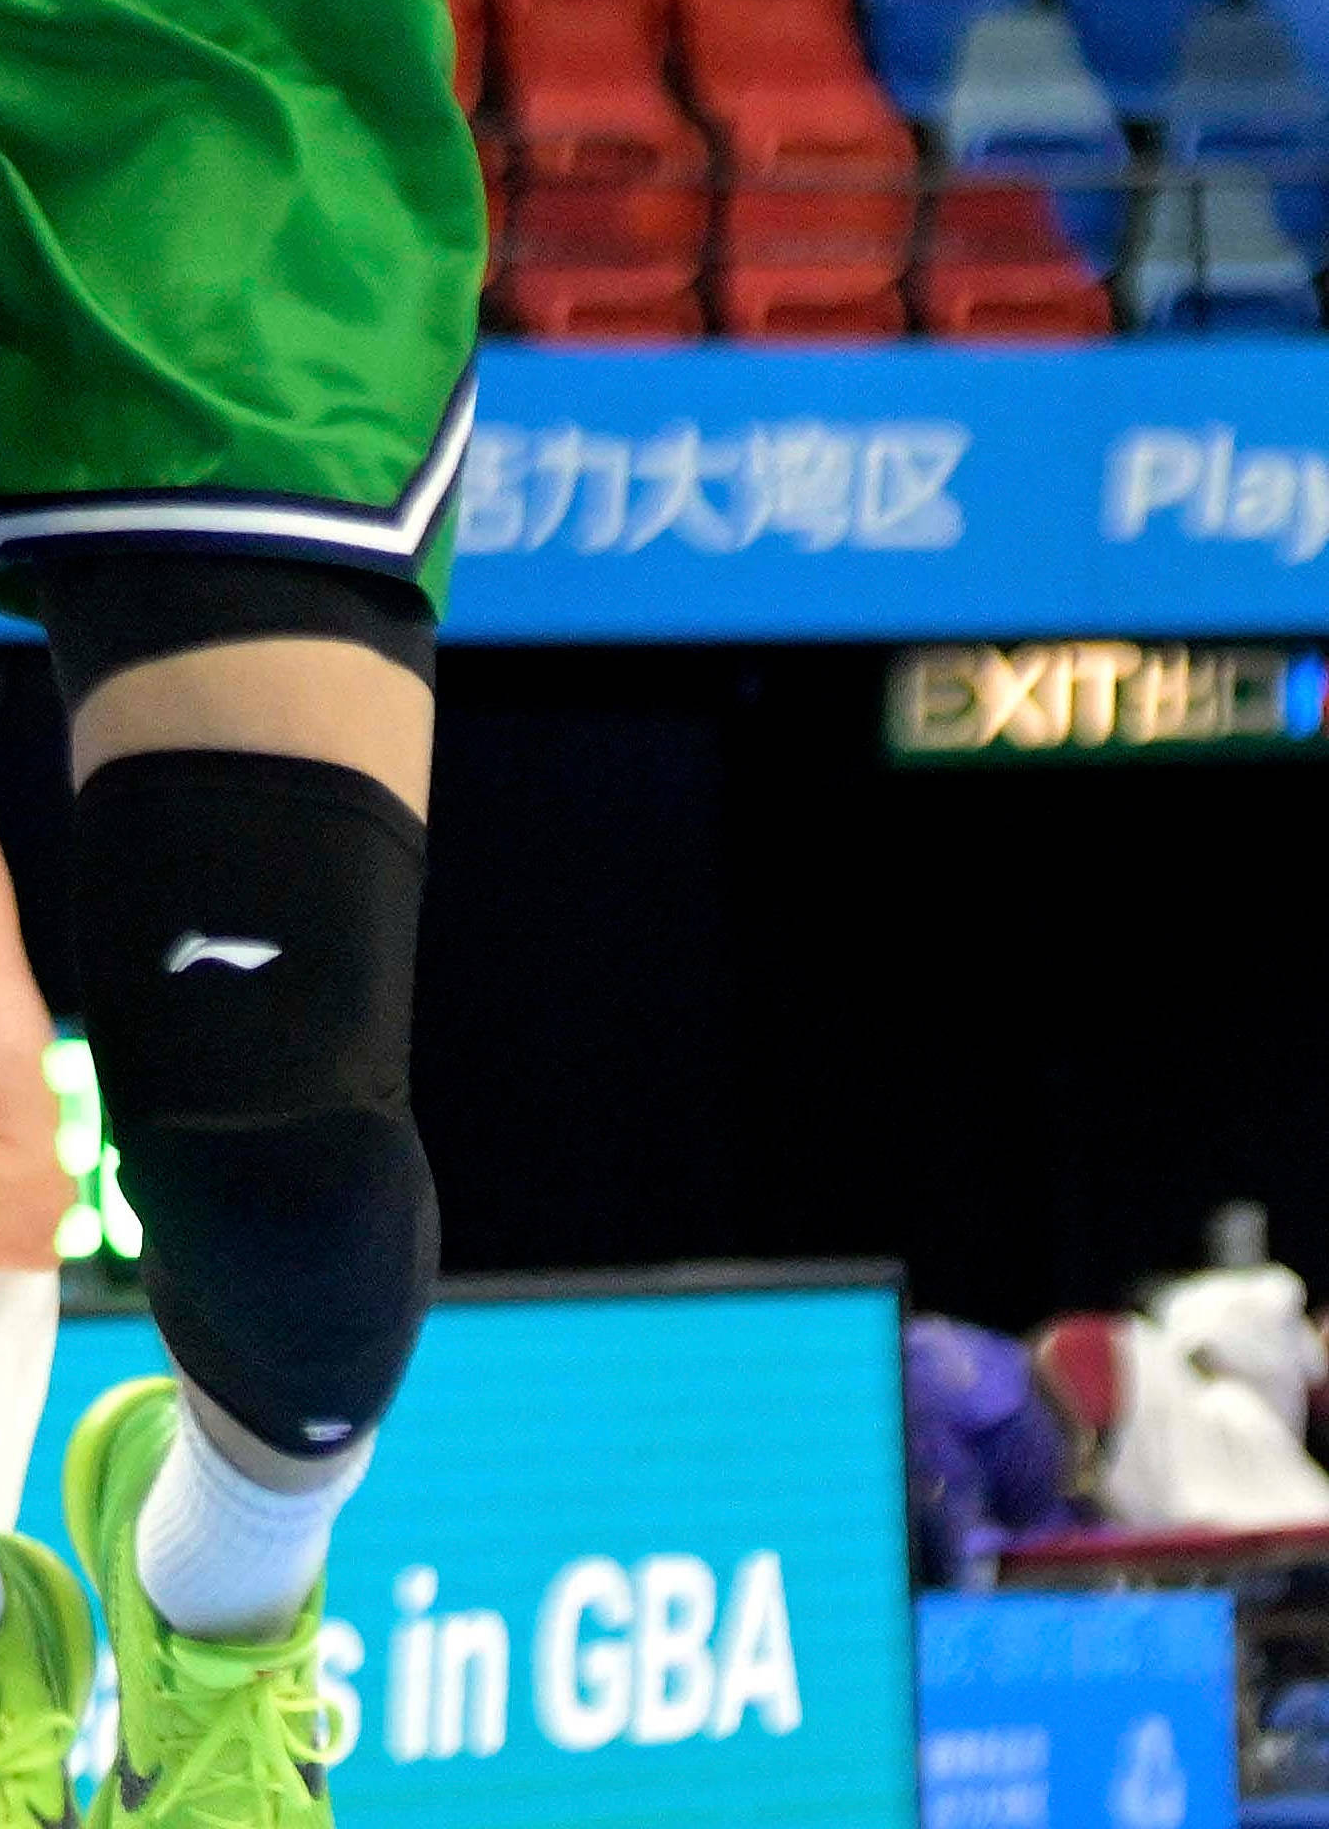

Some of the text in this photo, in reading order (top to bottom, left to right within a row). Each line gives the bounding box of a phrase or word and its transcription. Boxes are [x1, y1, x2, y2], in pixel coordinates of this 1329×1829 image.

[891, 640, 1141, 749] EXIT
[383, 1563, 511, 1763] in
[533, 1548, 804, 1753] GBA
